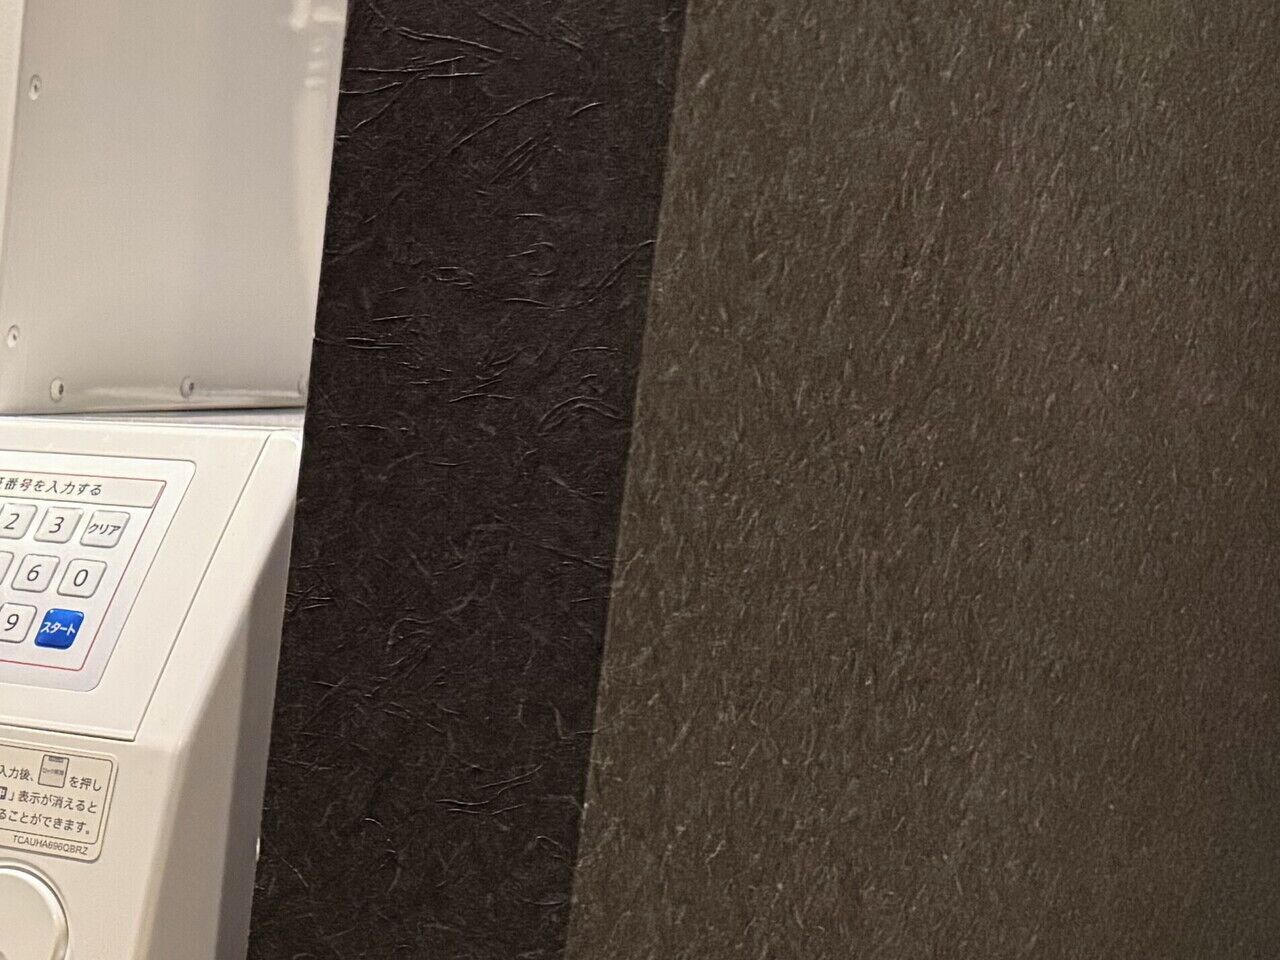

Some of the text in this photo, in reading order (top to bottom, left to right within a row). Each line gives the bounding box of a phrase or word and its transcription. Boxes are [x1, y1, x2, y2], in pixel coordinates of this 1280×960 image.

[3, 513, 20, 531] 2
[49, 517, 64, 534] 3
[88, 523, 121, 537] クリア
[27, 564, 40, 582] 6
[73, 569, 88, 588] 0
[6, 613, 19, 631] 9
[40, 621, 76, 636] スタート
[69, 775, 102, 793] を押し
